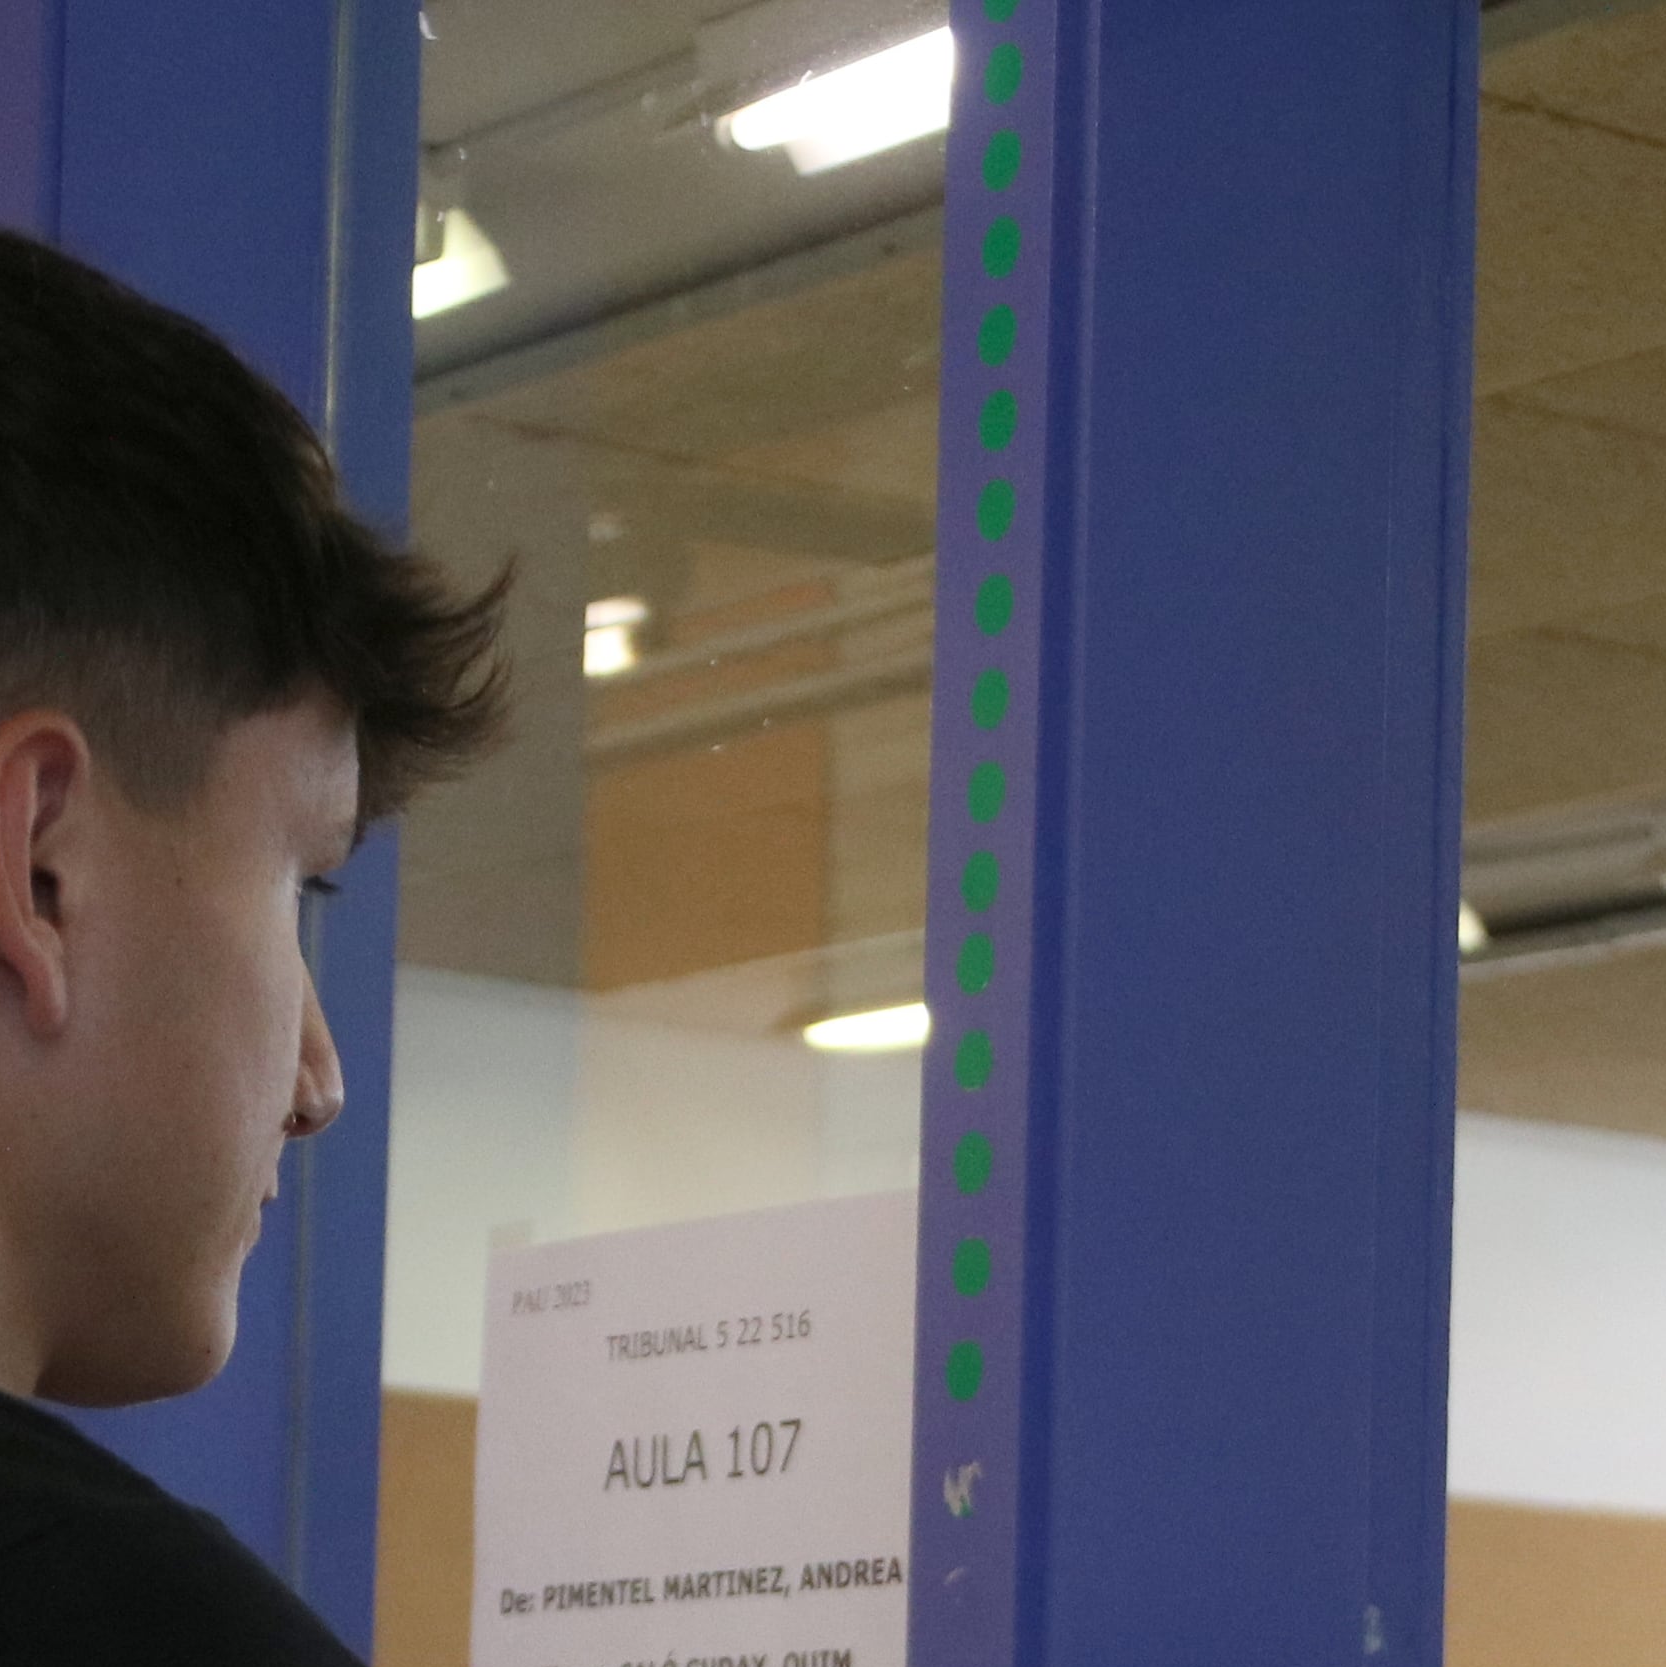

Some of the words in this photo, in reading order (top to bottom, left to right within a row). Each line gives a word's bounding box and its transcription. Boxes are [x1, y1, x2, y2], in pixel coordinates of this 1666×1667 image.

[606, 1325, 709, 1361] TRIBUNAL
[736, 1316, 762, 1346] 22
[772, 1310, 812, 1342] 516
[604, 1430, 708, 1491] AULA
[727, 1418, 804, 1478] 107
[500, 1587, 535, 1615] De:
[542, 1577, 655, 1612] PIMENTEL
[662, 1565, 791, 1601] MARTINEZ,
[799, 1556, 903, 1591] ANDREA
